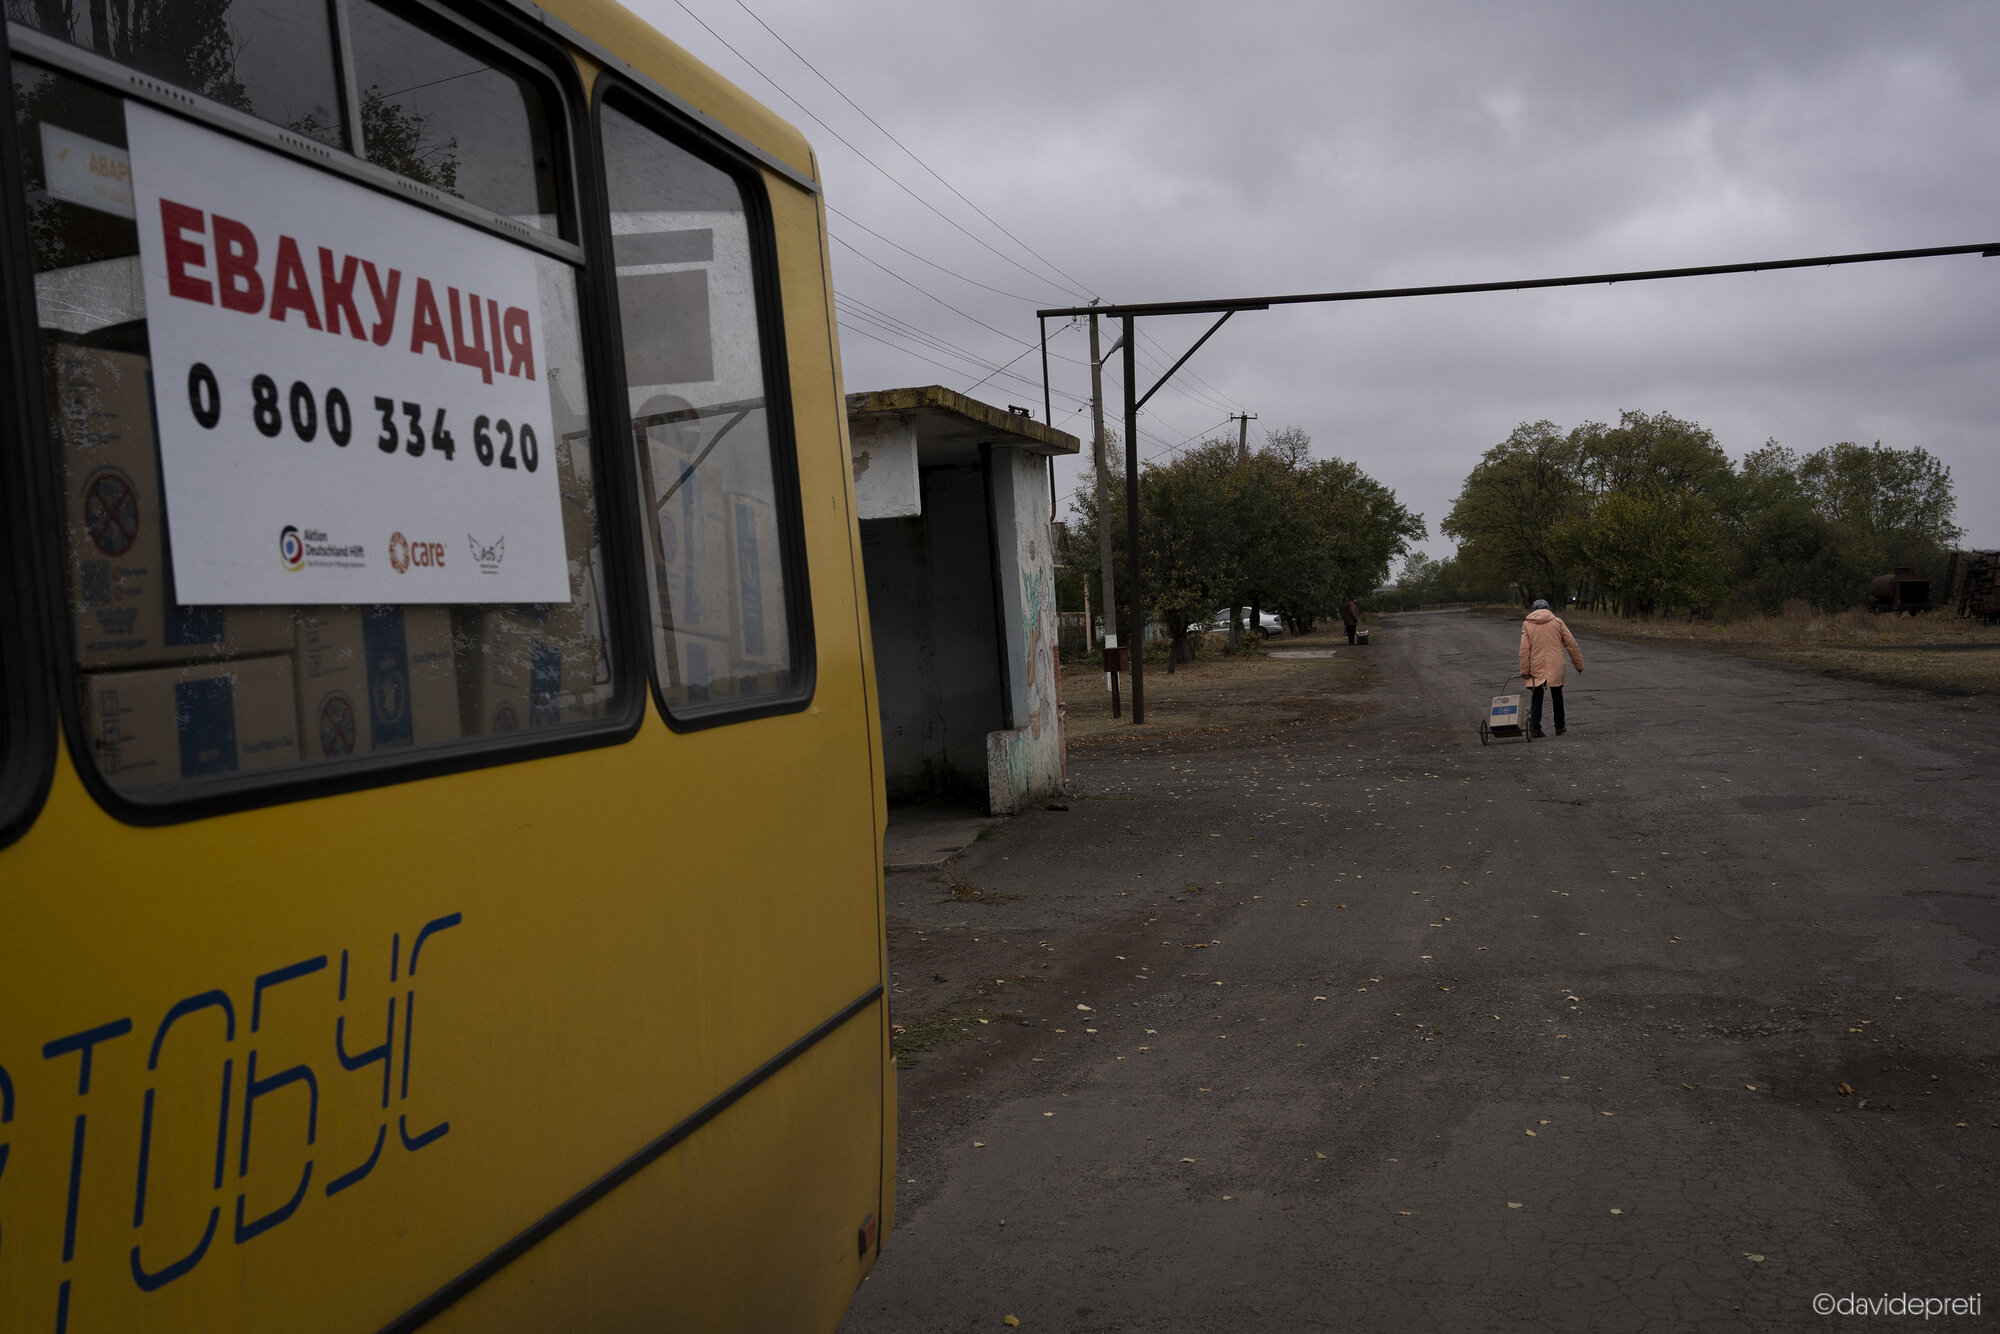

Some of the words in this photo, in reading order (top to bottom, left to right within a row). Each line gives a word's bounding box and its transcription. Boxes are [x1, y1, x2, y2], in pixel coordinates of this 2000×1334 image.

[159, 198, 536, 385] ЕВАКУАЦІЯ
[188, 362, 221, 430] 0
[251, 373, 352, 448] 800
[374, 396, 456, 462] 334
[473, 415, 540, 473] 620
[304, 529, 328, 542] Aktion
[305, 544, 348, 557] Deutschland
[349, 545, 365, 558] Hilft
[411, 541, 445, 567] care
[0, 911, 463, 1334] ТОБУС
